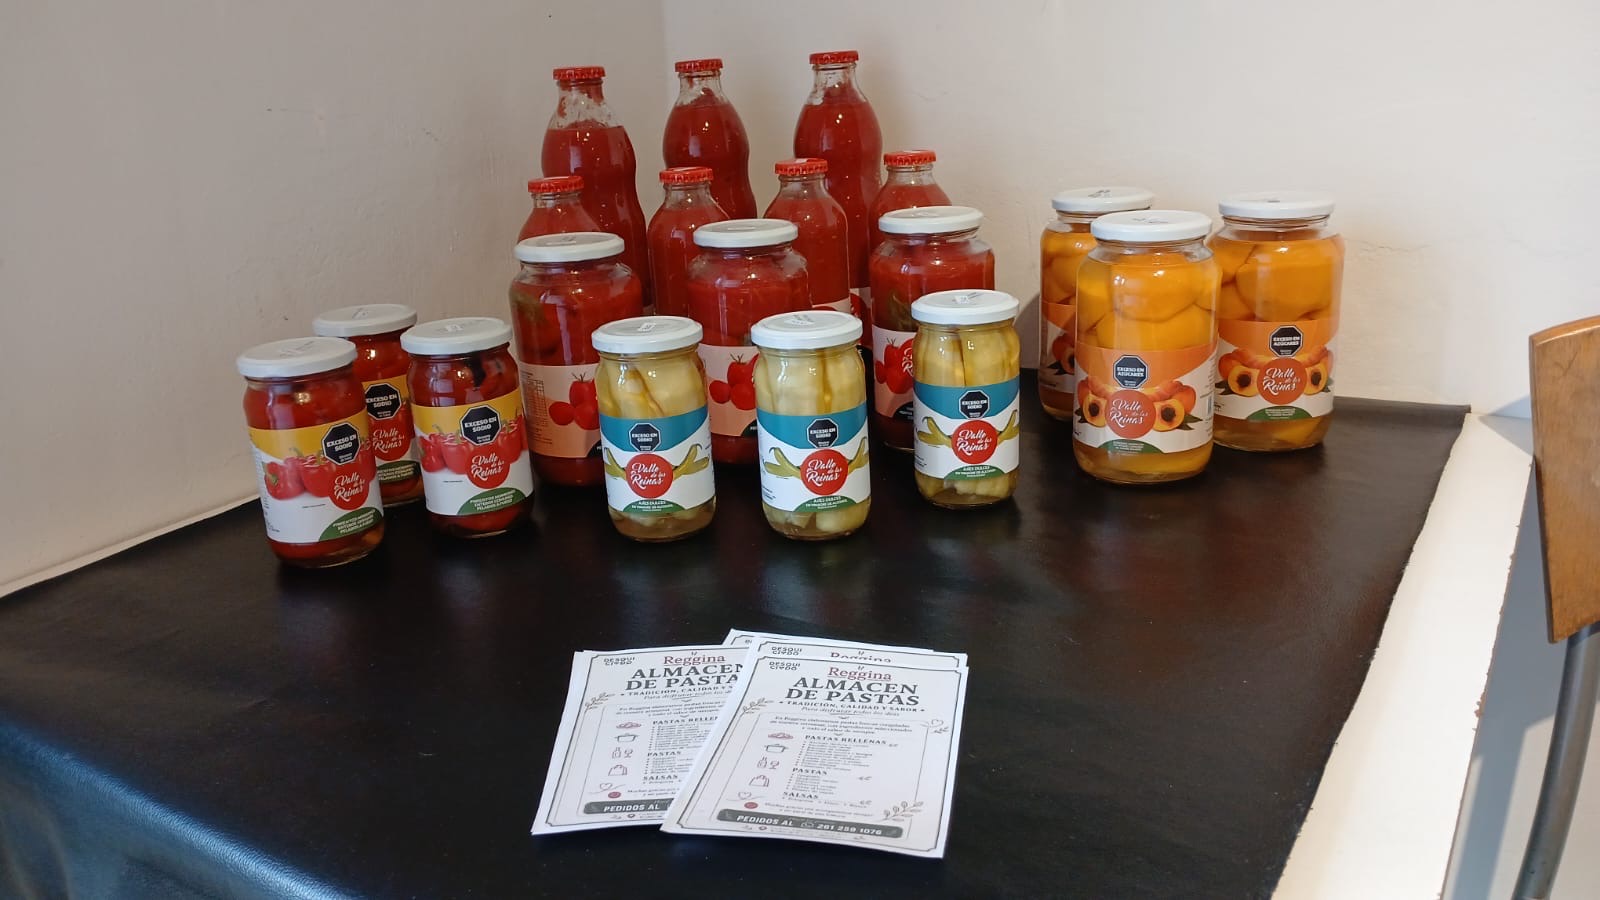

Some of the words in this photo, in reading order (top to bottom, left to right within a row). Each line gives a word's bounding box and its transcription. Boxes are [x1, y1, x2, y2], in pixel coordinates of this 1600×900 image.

[1266, 368, 1295, 378] Valle
[1263, 376, 1296, 396] Reinas
[1112, 399, 1141, 410] Valle
[465, 419, 488, 428] EXCESO
[1110, 407, 1143, 428] Reinas
[373, 428, 398, 439] Valle
[472, 424, 492, 432] SODIO
[959, 429, 987, 440] Valle
[373, 438, 402, 453] Reinas
[957, 438, 989, 456] Reinas
[472, 453, 498, 466] Valle
[808, 458, 837, 470] Valle
[471, 464, 503, 481] Reinas
[632, 463, 659, 473] Valle
[335, 472, 359, 486] Valle
[630, 470, 663, 490] Reinas
[806, 468, 840, 486] Reinas
[334, 484, 363, 501] Reinas
[664, 655, 726, 666] Reggina
[828, 667, 892, 680] Reggina
[625, 680, 656, 690] DE
[666, 674, 738, 687] PASTA
[793, 677, 918, 694] ALMACEN
[785, 688, 818, 700] DE
[825, 691, 919, 705] PASTAS
[736, 815, 779, 825] PEDIDOS
